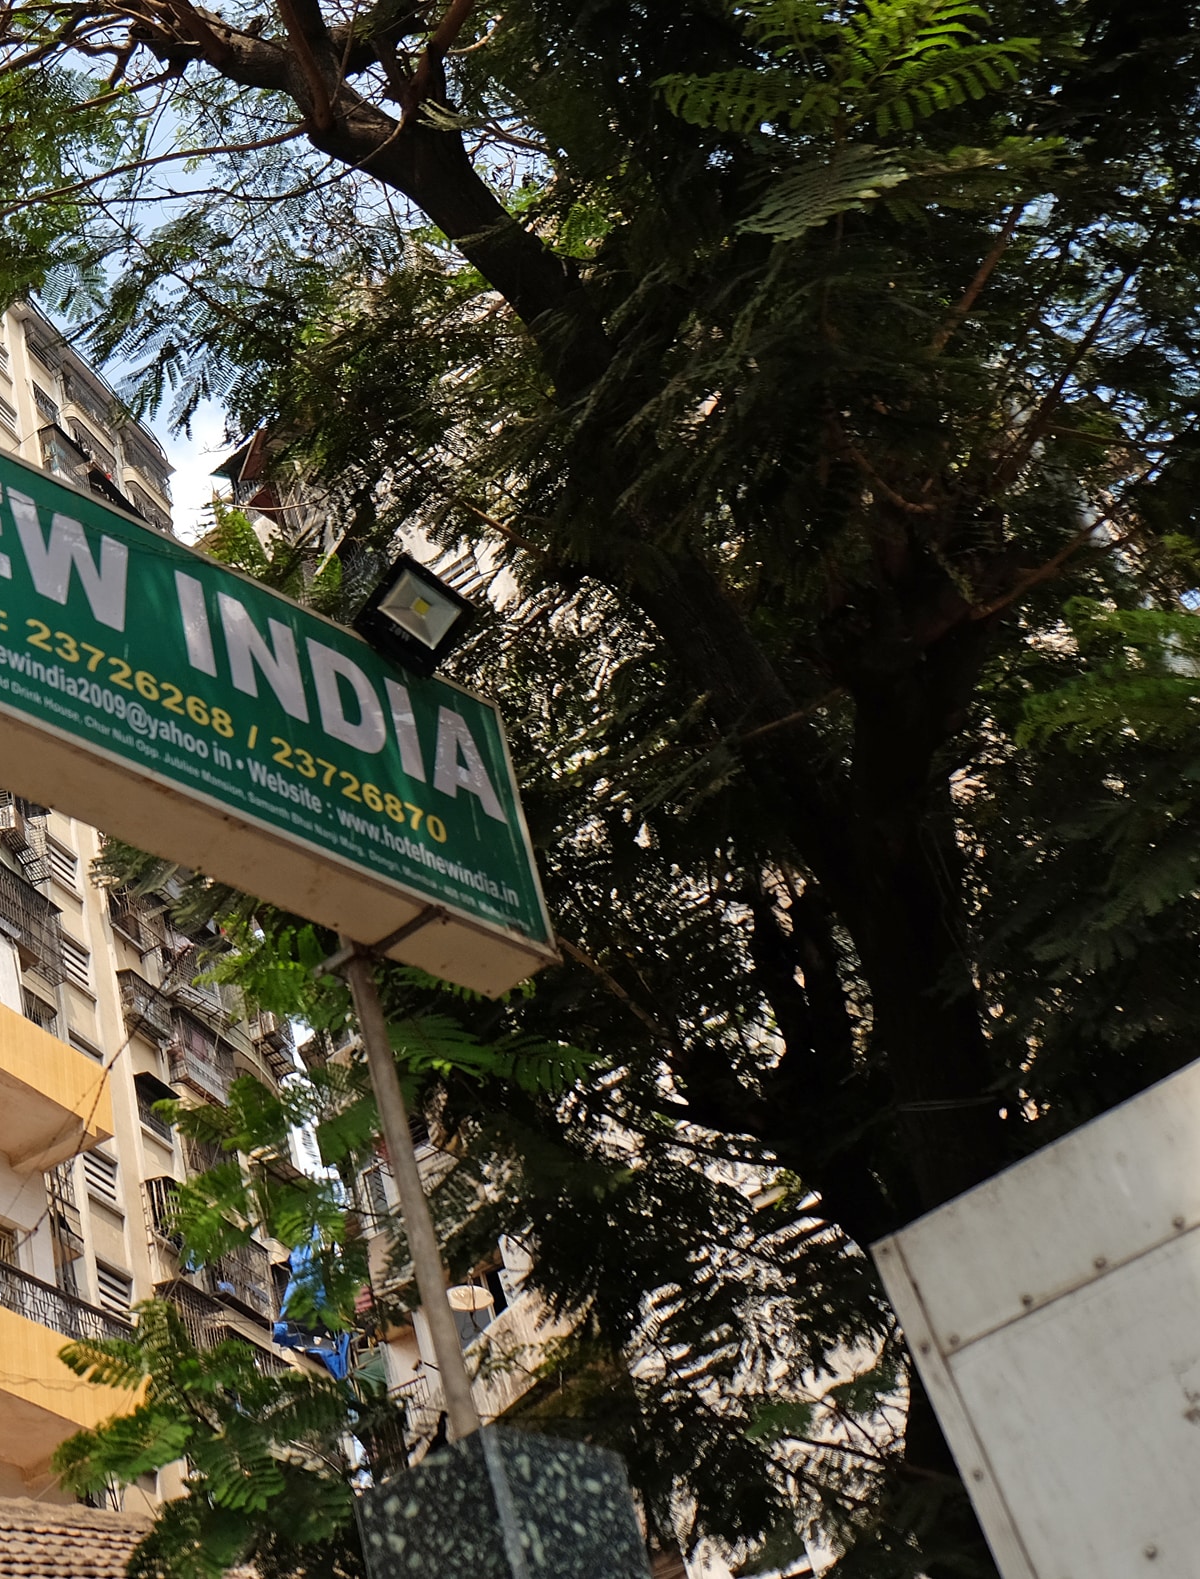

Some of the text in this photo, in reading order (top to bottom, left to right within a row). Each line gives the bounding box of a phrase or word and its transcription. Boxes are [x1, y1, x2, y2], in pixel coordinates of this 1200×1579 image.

[11, 681, 43, 705] Drink
[25, 618, 235, 739] 23726268
[270, 736, 448, 844] 23726870
[174, 568, 508, 824] INDIA
[247, 757, 323, 815] Website
[336, 807, 521, 908] www.hotelnewindia.in
